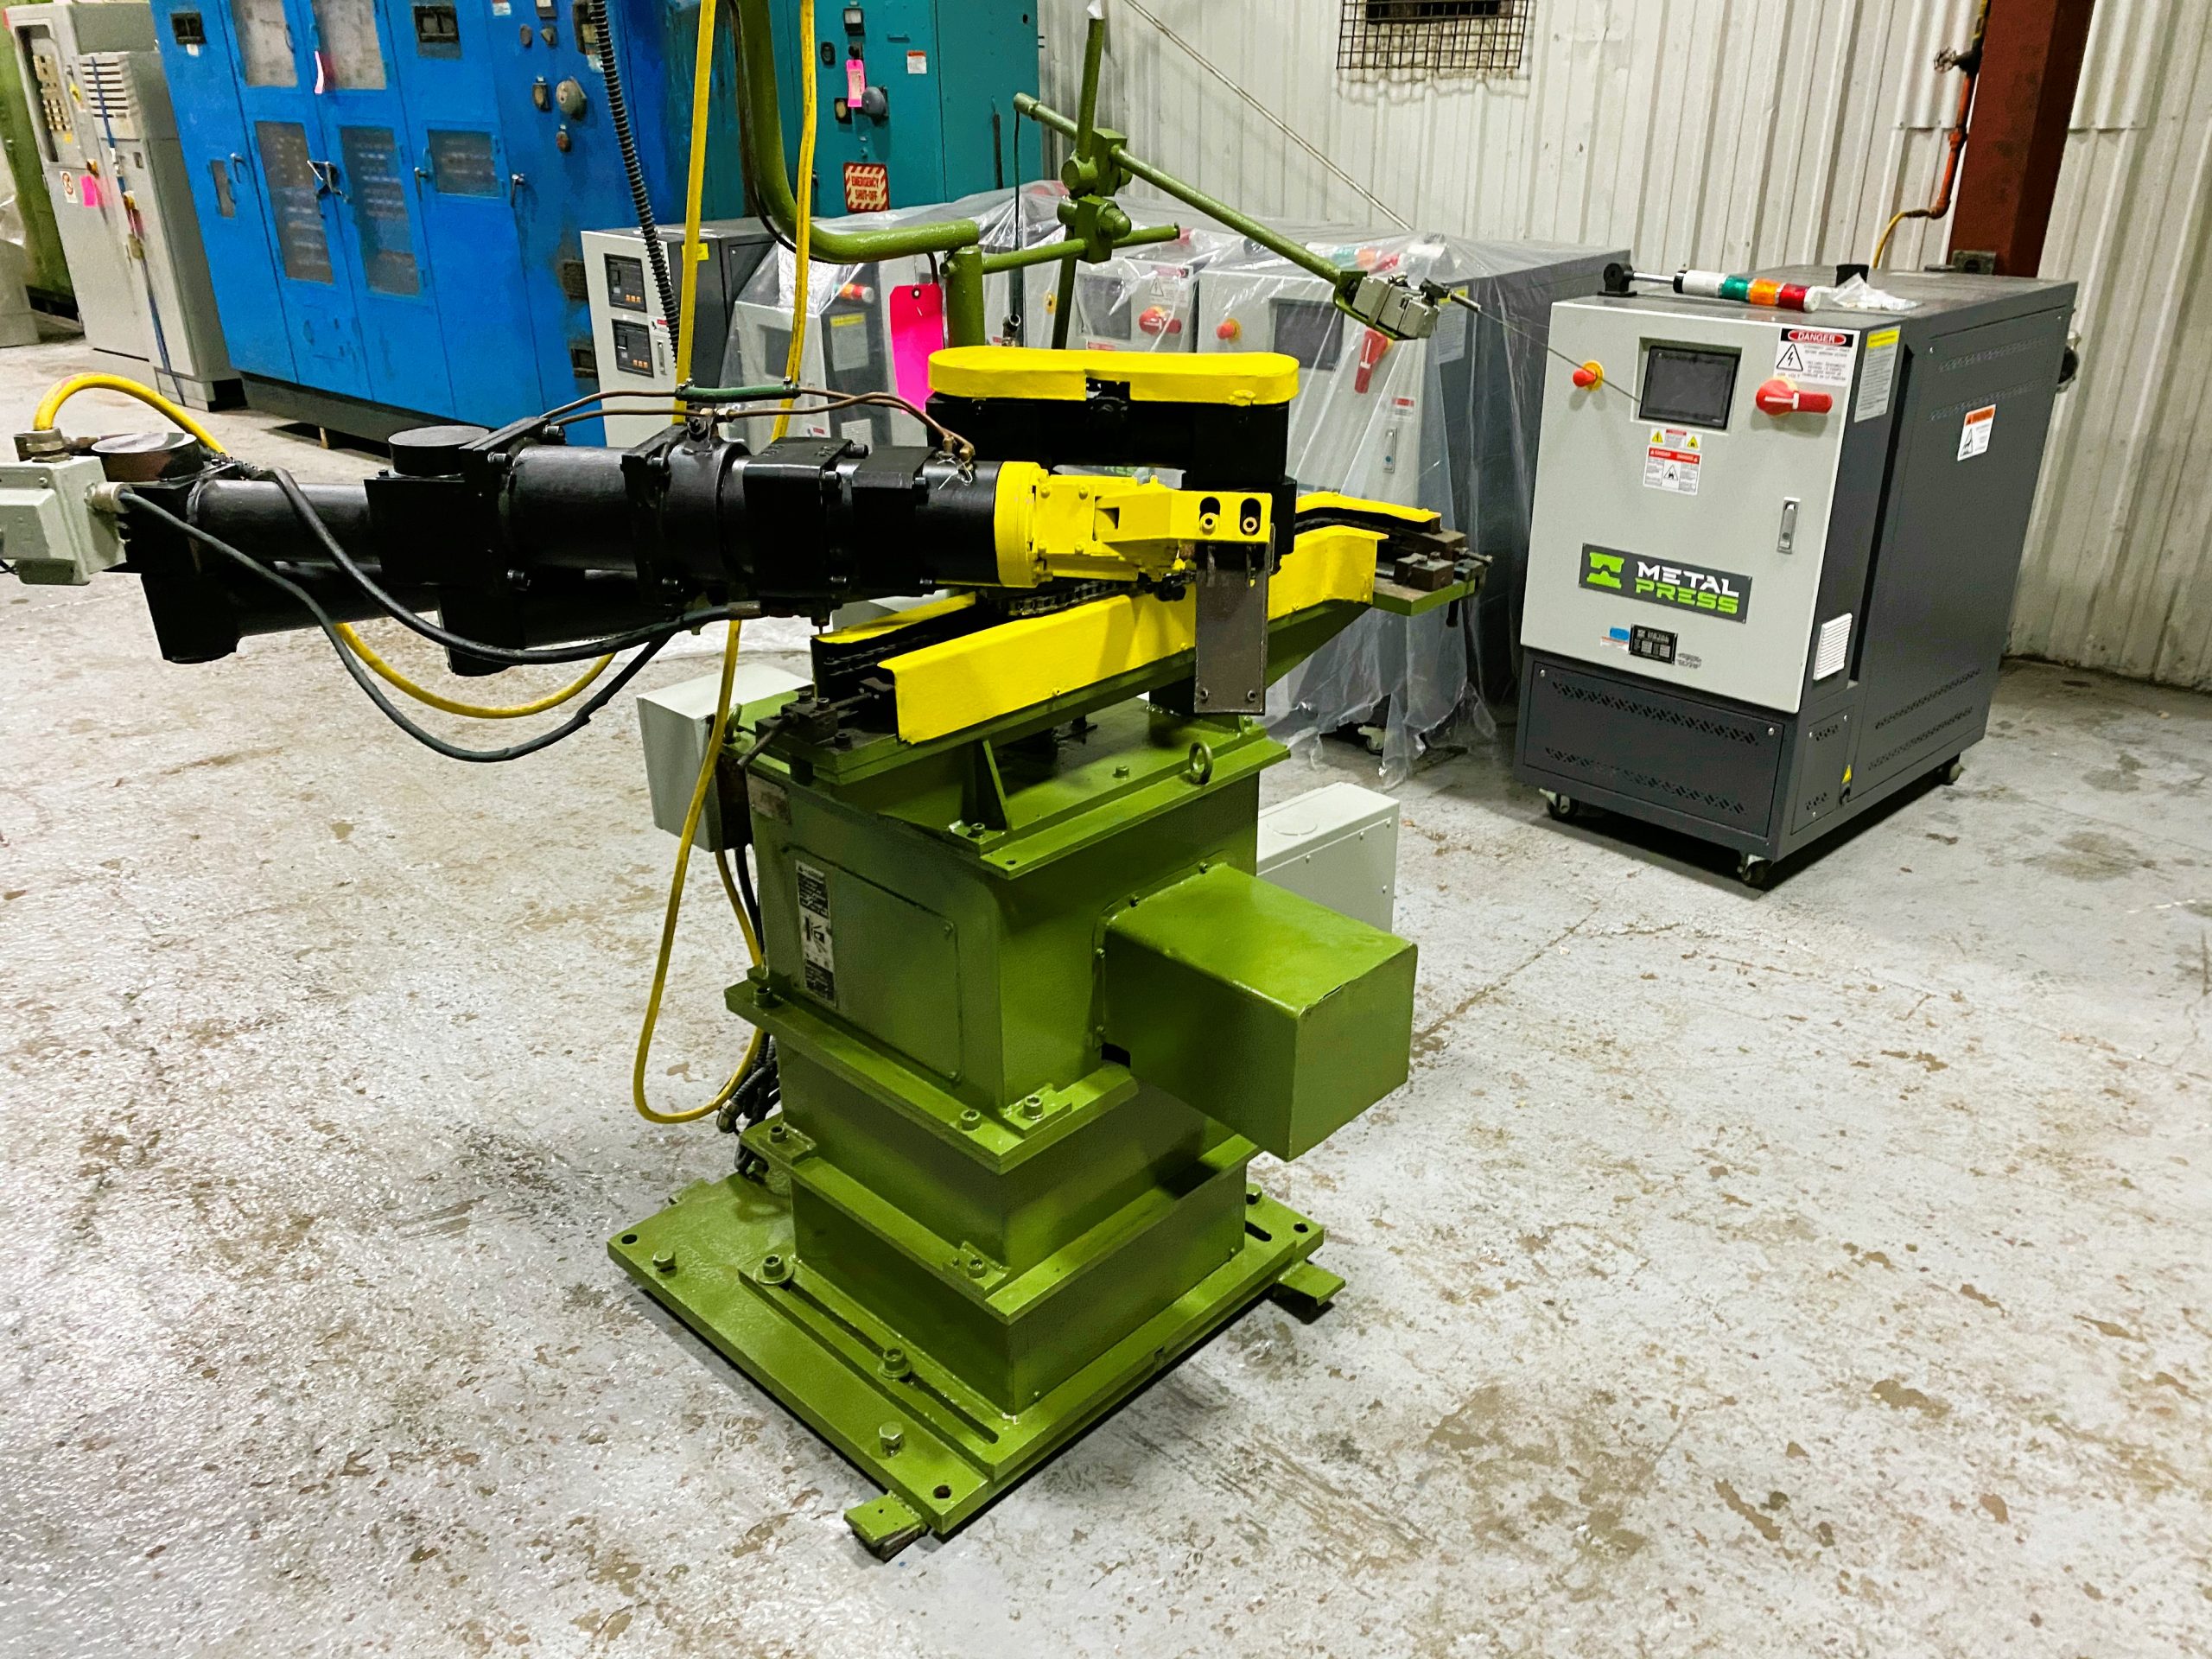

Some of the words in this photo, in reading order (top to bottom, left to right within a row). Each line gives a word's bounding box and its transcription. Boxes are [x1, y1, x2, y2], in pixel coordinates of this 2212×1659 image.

[1797, 329, 1835, 345] DANGER
[1635, 577, 1739, 614] PRESS
[1637, 561, 1739, 598] METAL
